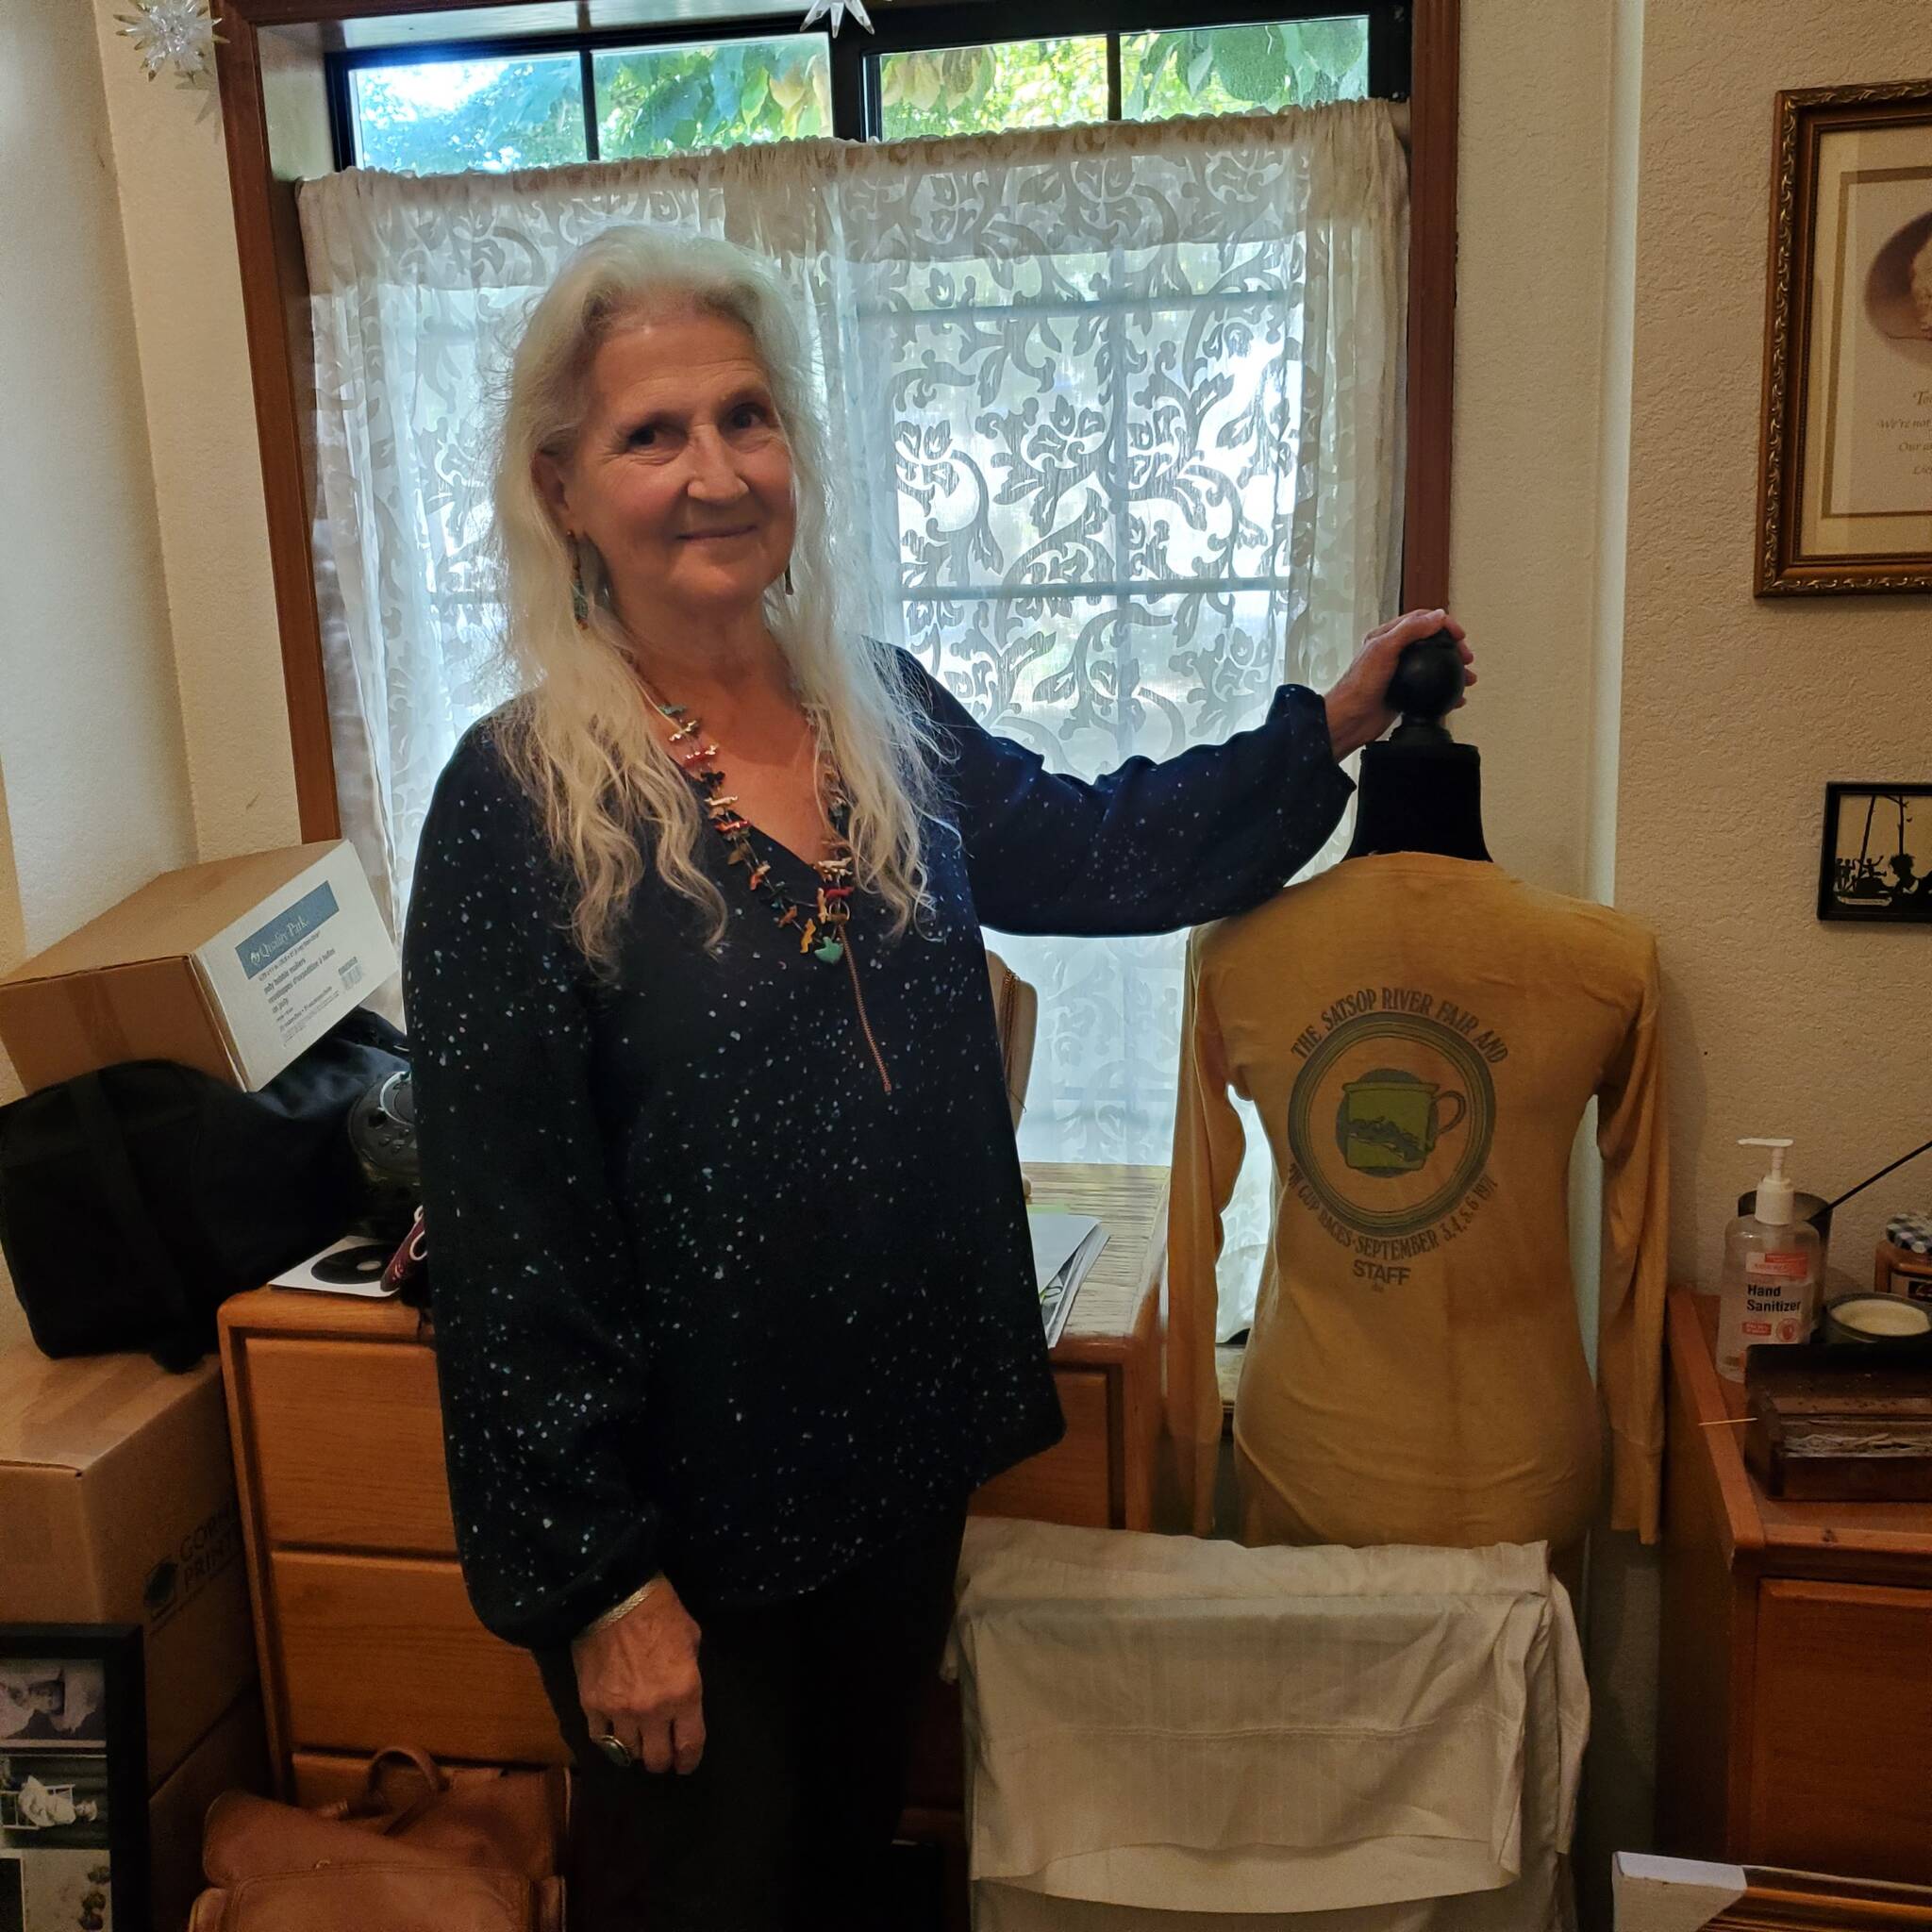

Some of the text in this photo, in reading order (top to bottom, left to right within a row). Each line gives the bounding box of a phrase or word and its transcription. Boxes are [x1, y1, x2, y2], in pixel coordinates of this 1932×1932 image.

[1291, 987, 1508, 1064] THE SATSOP RIVER FAIR AND
[1297, 1185, 1320, 1211] CUP
[1355, 1229, 1439, 1261] SEPTEMBER
[1352, 1259, 1411, 1285] STAFF
[1747, 1283, 1782, 1297] Hand
[1746, 1299, 1801, 1312] Sanitizer
